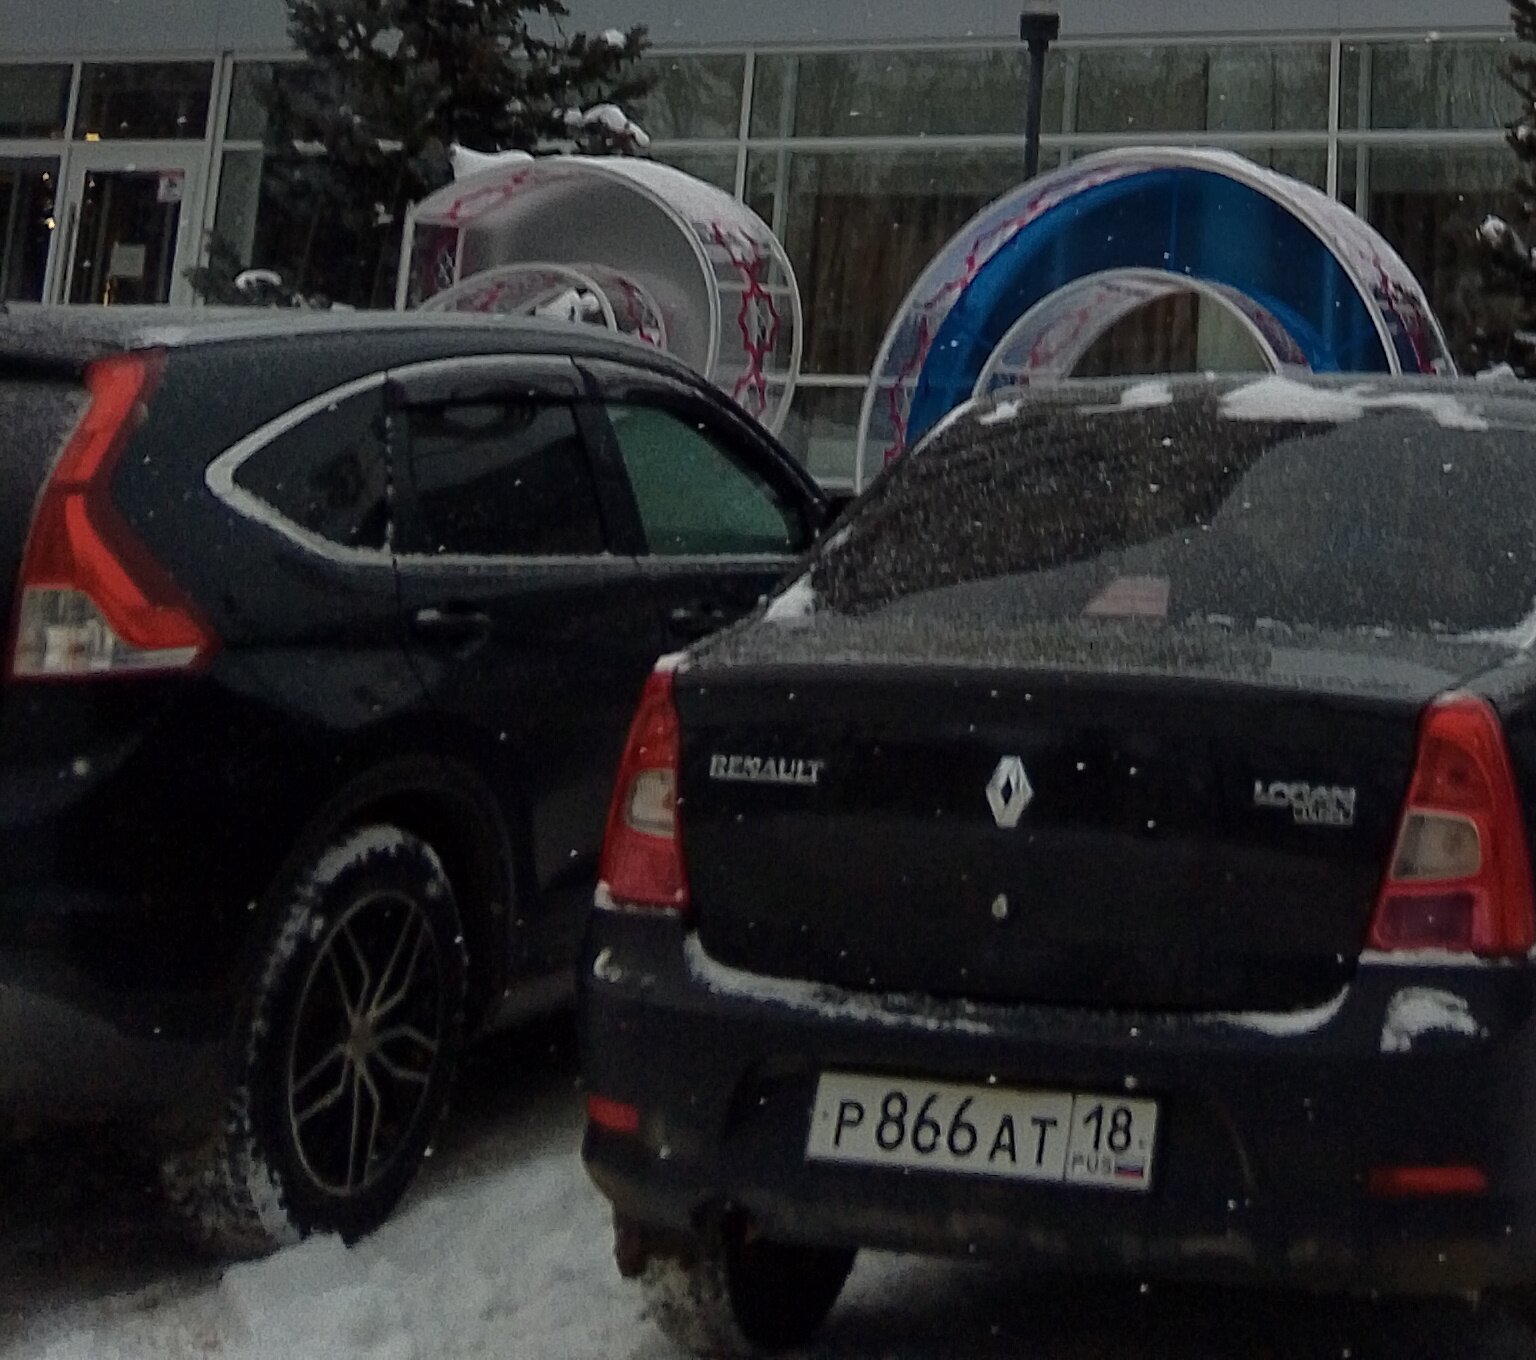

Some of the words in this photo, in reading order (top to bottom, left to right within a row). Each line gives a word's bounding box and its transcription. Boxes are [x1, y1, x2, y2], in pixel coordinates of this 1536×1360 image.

[709, 753, 824, 784] RENAULT
[1253, 779, 1356, 811] LOGAN
[833, 1090, 1059, 1166] Р866АТ
[1084, 1105, 1133, 1152] 18
